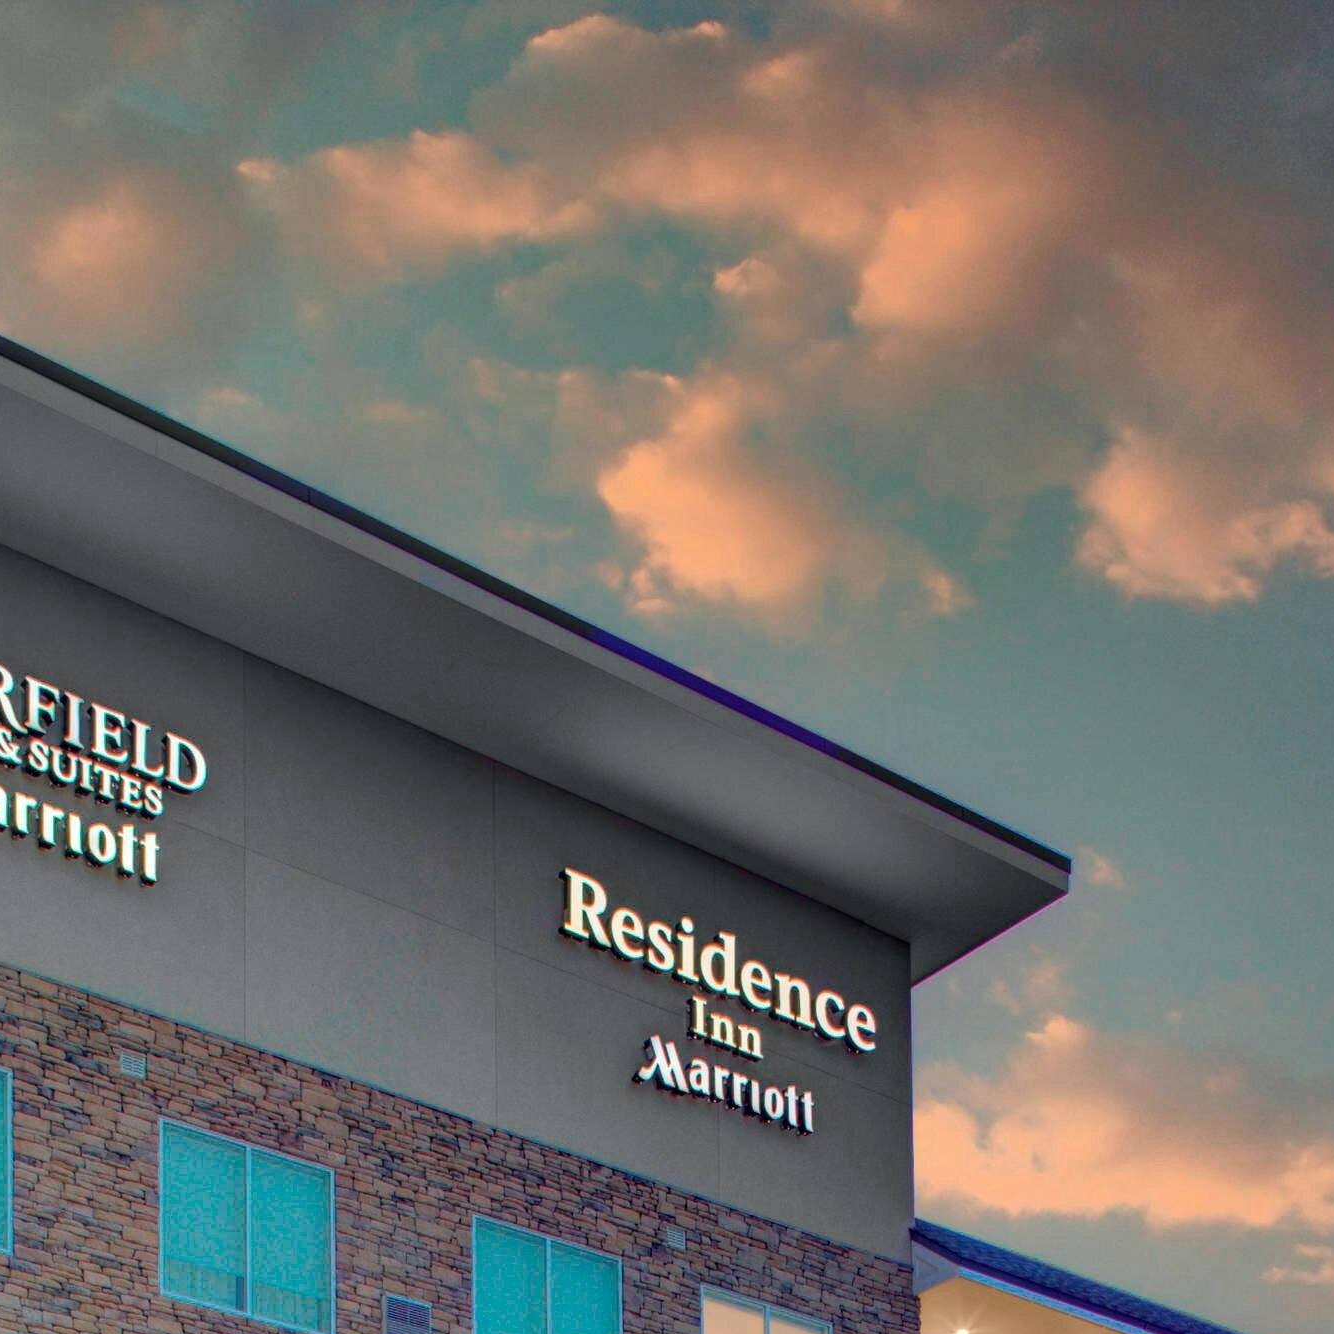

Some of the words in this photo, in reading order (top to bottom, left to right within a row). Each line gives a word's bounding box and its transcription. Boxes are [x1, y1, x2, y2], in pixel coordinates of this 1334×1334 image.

[28, 740, 164, 818] SUITES
[563, 866, 877, 1052] Residence
[690, 994, 764, 1060] Inn
[637, 1034, 815, 1134] Marriott
